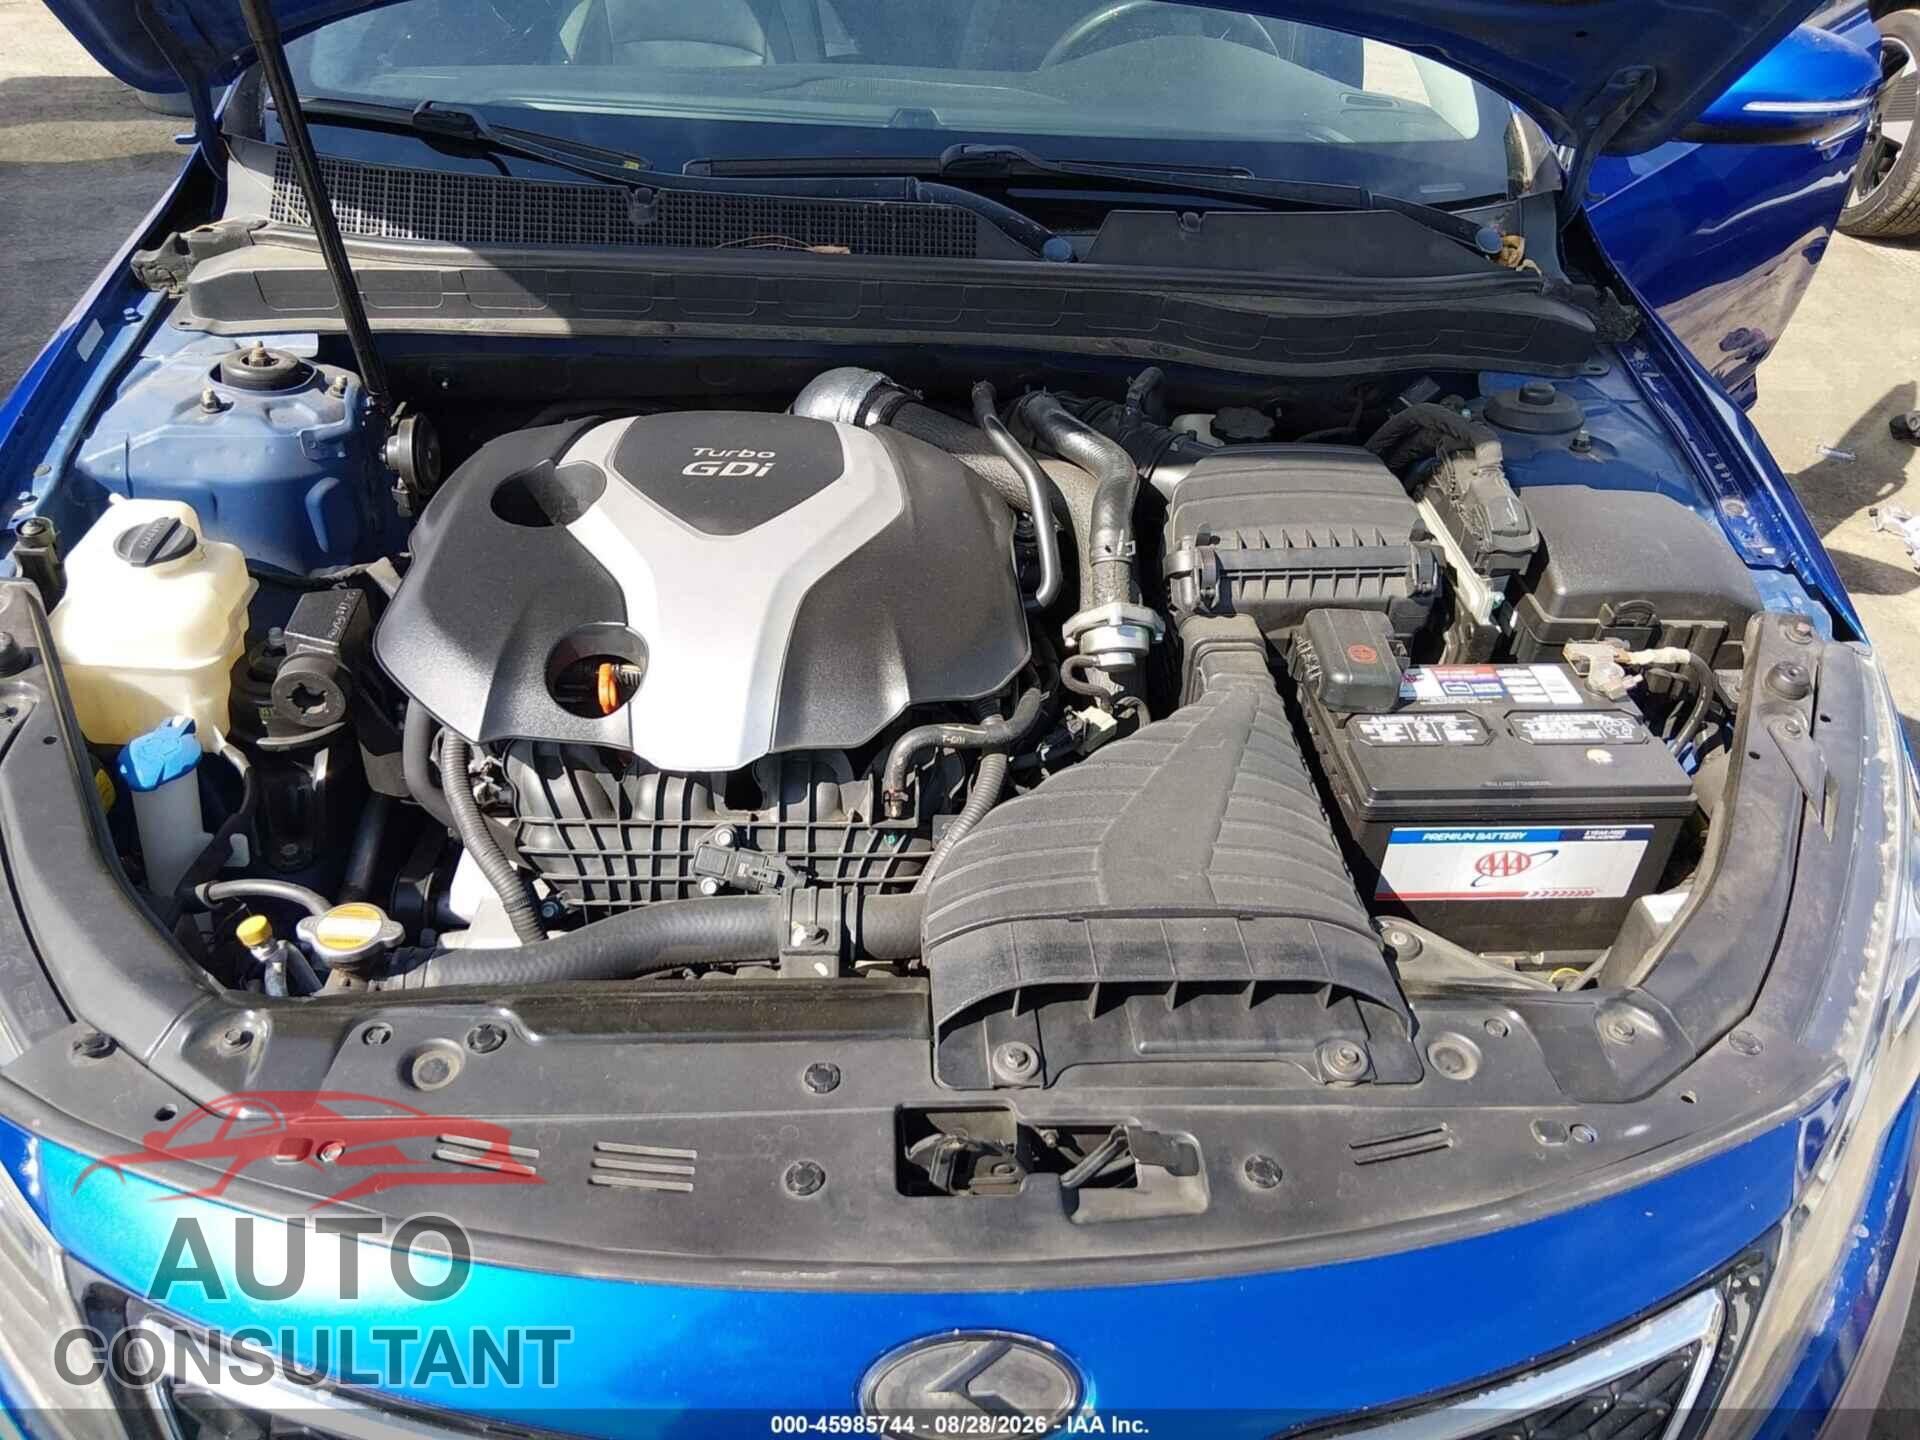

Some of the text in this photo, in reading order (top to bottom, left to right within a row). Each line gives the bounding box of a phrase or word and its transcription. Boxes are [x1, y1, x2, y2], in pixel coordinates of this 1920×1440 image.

[692, 447, 776, 458] Turbo
[681, 461, 776, 477] GDi
[1422, 831, 1527, 841] PREMIUM BATTERY
[1478, 850, 1528, 877] AAA
